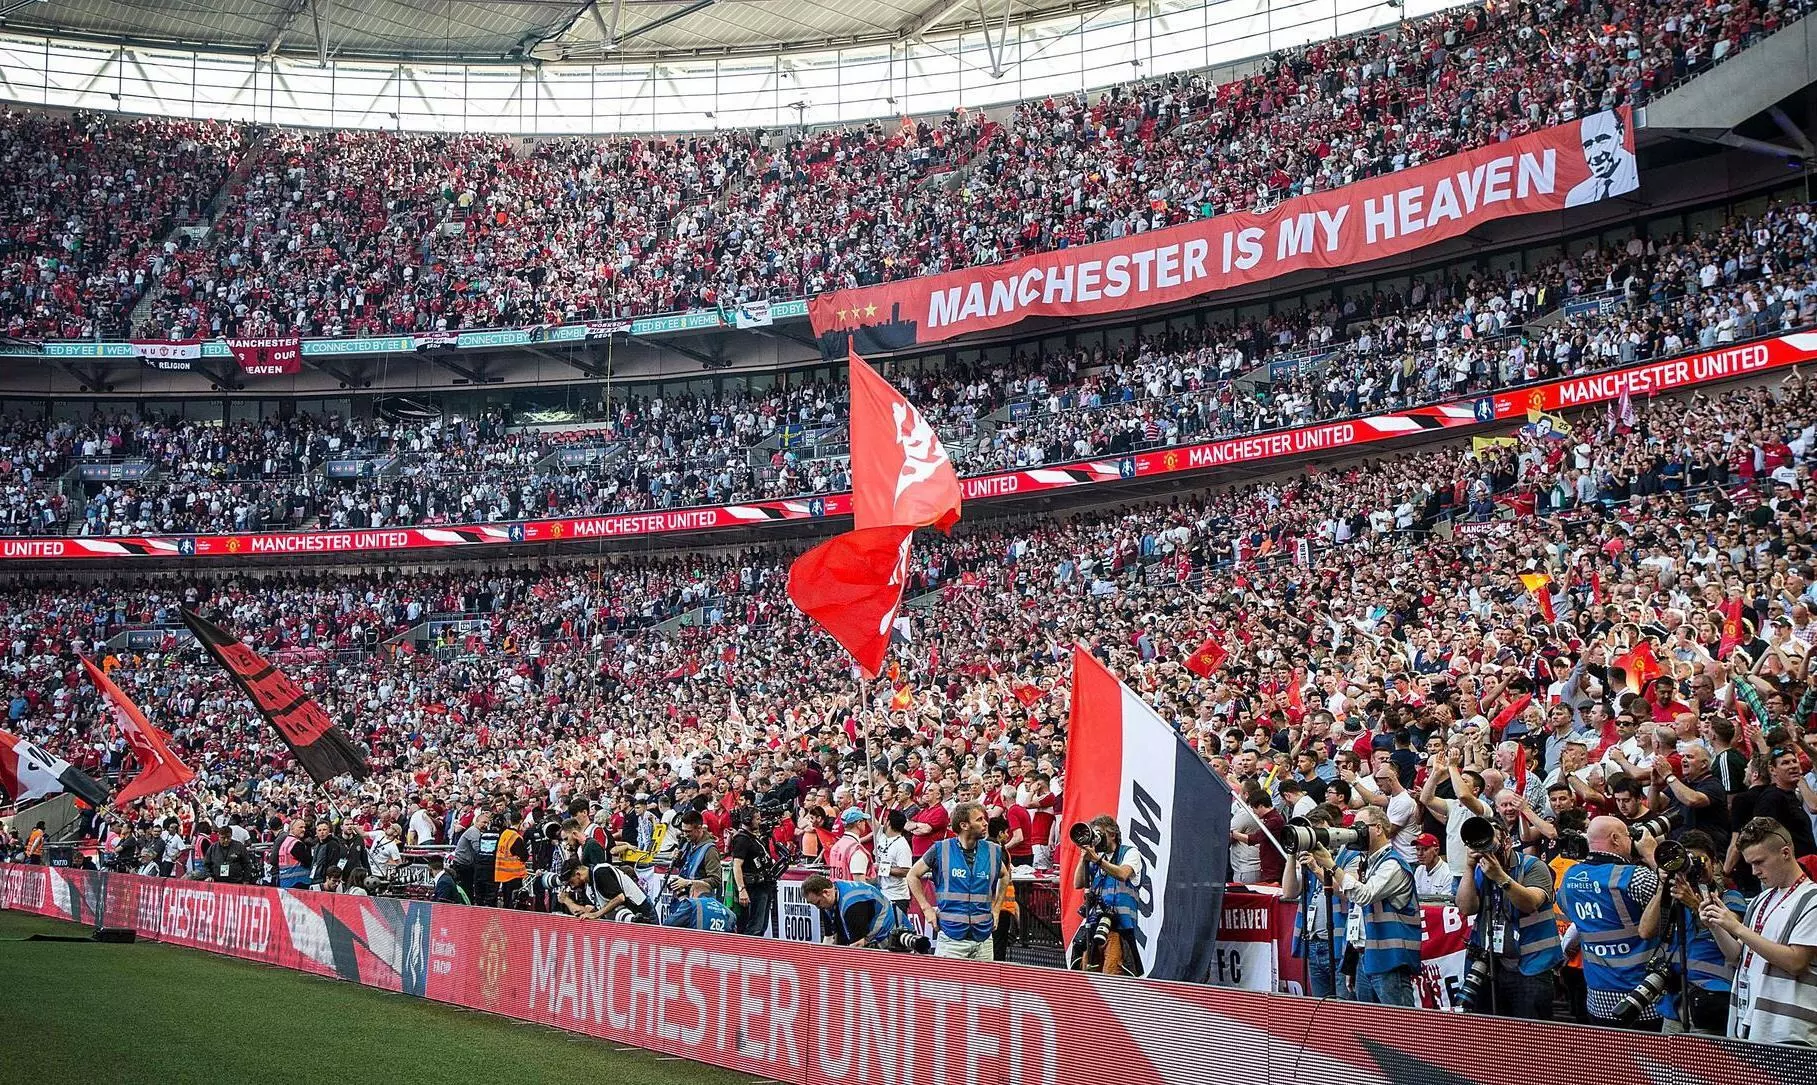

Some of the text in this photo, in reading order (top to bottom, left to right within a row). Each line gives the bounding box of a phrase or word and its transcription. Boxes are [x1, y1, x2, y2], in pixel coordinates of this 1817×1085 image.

[927, 148, 1556, 328] MANCHESTER IS MY HEAVEN
[790, 304, 801, 313] BY
[227, 339, 298, 348] MANCHESTER
[314, 342, 371, 352] CONNECTED
[373, 341, 385, 350] BY
[458, 334, 515, 345] CONNECTED
[274, 351, 296, 360] OUR
[159, 361, 190, 370] RELIGION
[1559, 344, 1769, 404] MANCHESTER UNITED
[1558, 422, 1569, 431] 25
[1189, 424, 1354, 467] MANCHESTER UNITED
[968, 476, 1018, 496] UNITED
[573, 511, 717, 537] MANCHESTER UNITED
[4, 541, 65, 556] UNITED
[252, 532, 408, 551] MANCHESTER UNITED
[952, 868, 967, 879] 082
[137, 884, 215, 943] MANCHESTER
[216, 893, 271, 953] UNITED
[784, 904, 811, 917] SOMETHING
[1575, 902, 1603, 920] 041
[710, 918, 725, 932] 262
[1224, 908, 1268, 930] HEAVEN
[785, 916, 812, 941] GOOD
[530, 929, 1056, 1085] MANCHESTER UNITED
